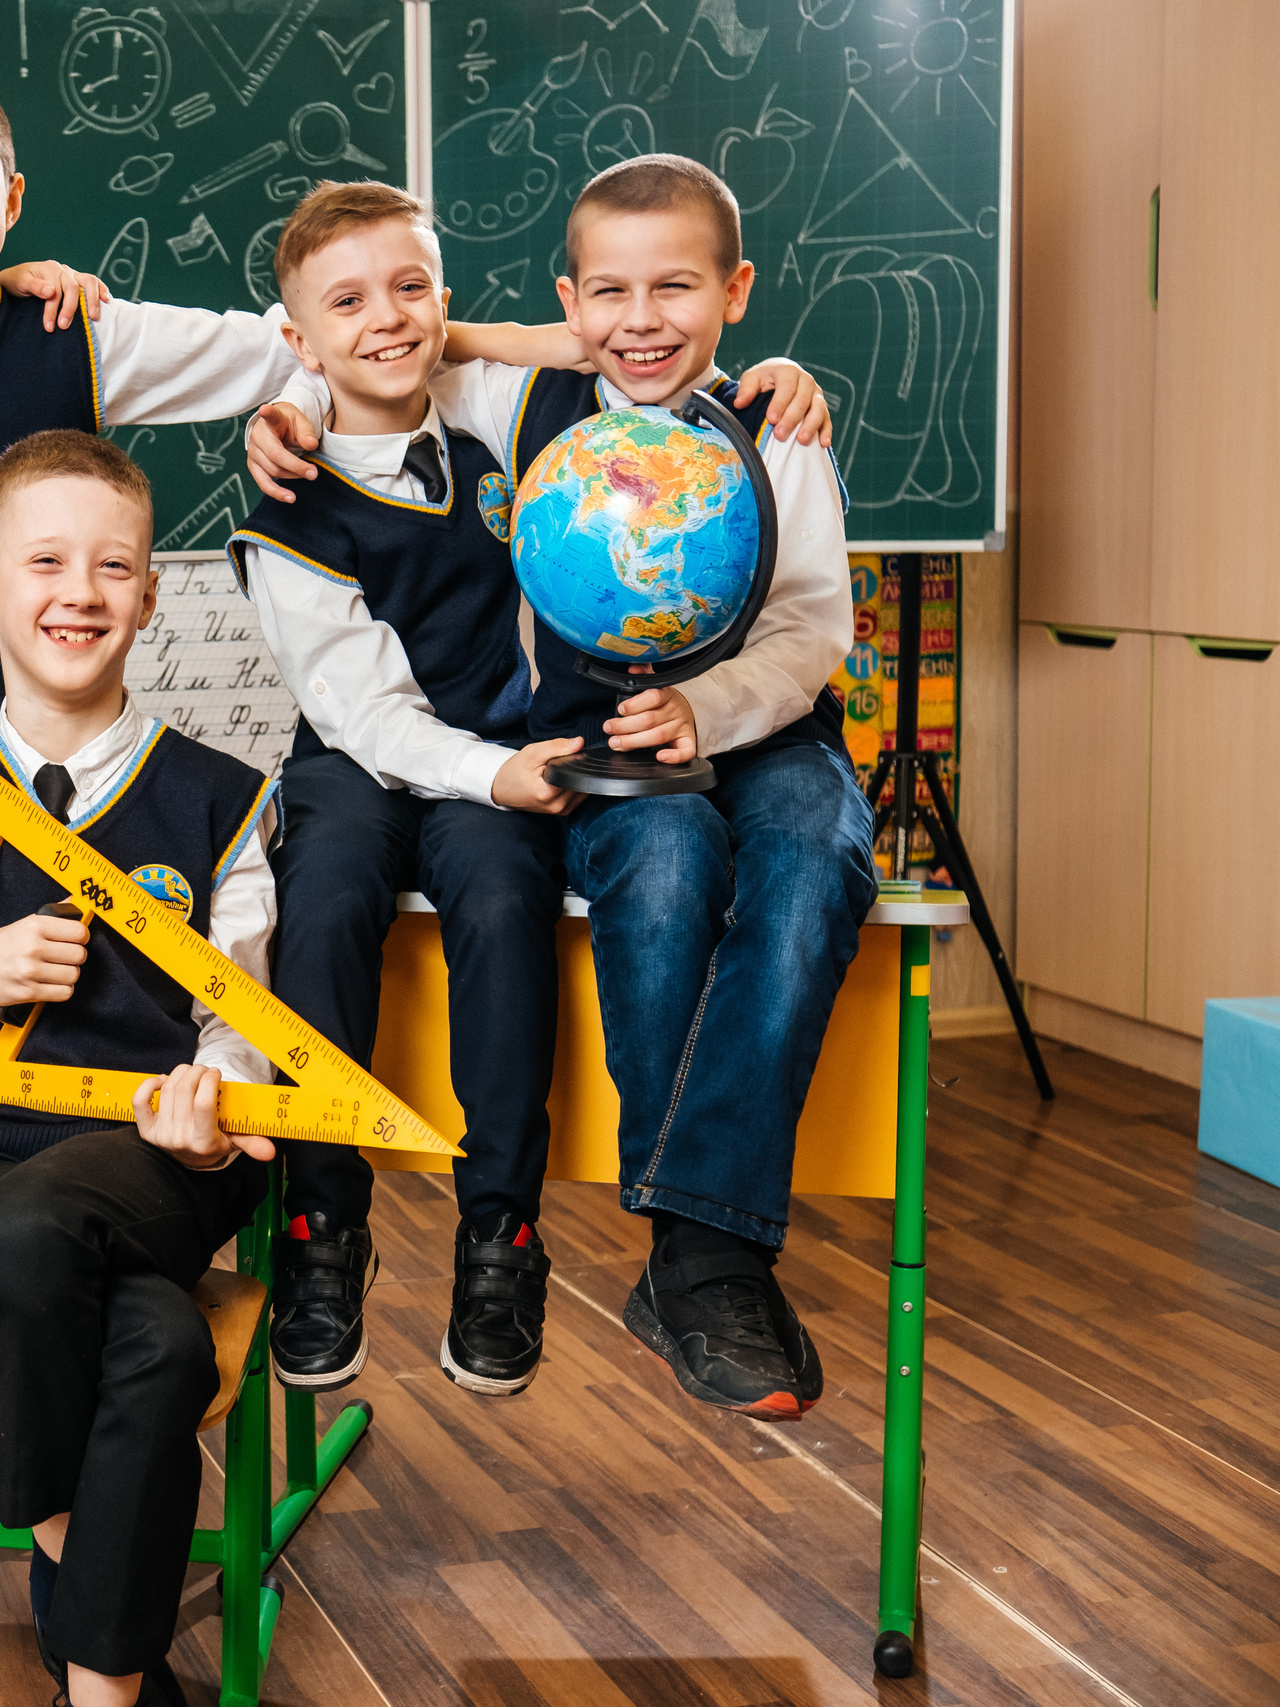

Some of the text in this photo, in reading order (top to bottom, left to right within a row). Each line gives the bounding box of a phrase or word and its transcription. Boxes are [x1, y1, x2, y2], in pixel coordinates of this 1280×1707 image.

[843, 47, 872, 83] B
[778, 242, 803, 288] A
[851, 570, 868, 600] 1
[854, 608, 875, 639] 6
[850, 647, 875, 678] 11
[848, 688, 877, 715] 16
[53, 850, 71, 872] 10
[125, 910, 147, 934] 20
[204, 975, 226, 1000] 30
[287, 1046, 309, 1070] 40
[372, 1116, 397, 1143] 50
[20, 1069, 35, 1080] 100
[21, 1083, 32, 1093] 50
[82, 1075, 93, 1086] 80
[80, 1088, 92, 1099] 40
[278, 1093, 291, 1105] 20
[277, 1107, 288, 1118] 10
